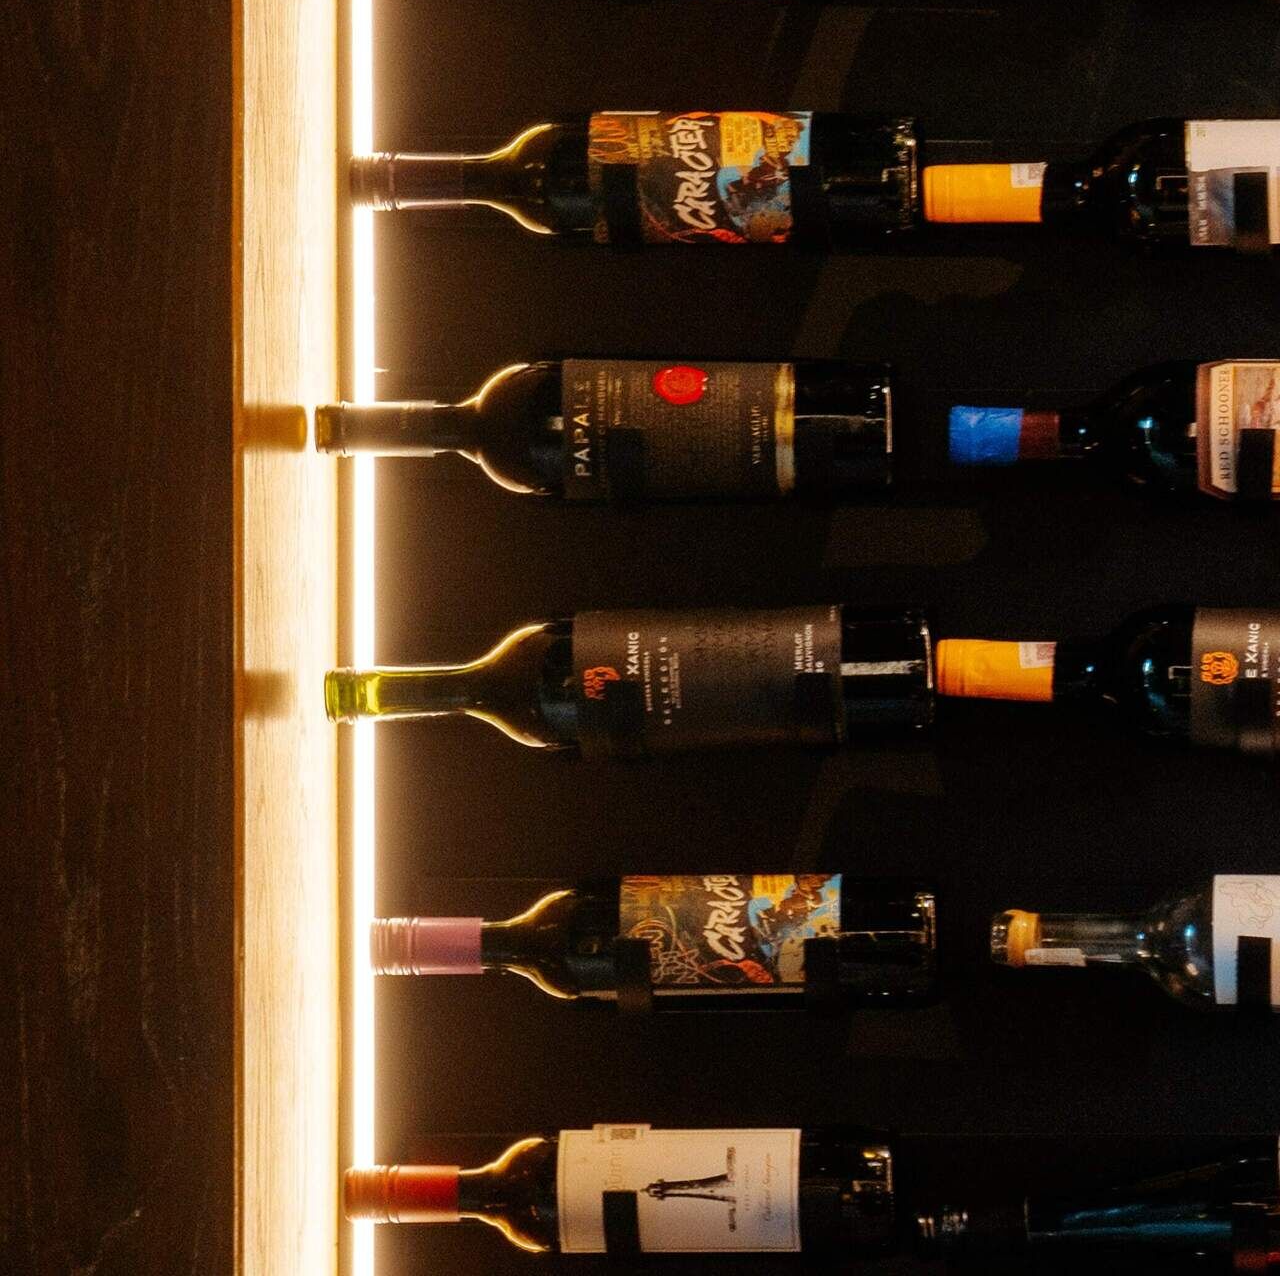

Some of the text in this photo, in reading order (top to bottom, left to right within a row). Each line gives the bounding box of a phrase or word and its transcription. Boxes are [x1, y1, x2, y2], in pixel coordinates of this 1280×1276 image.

[667, 119, 718, 230] CARACTER
[1217, 368, 1233, 481] RED SCHOONER
[626, 631, 641, 676] XANIC
[794, 633, 805, 671] MERLOT
[1245, 623, 1261, 664] XANIC
